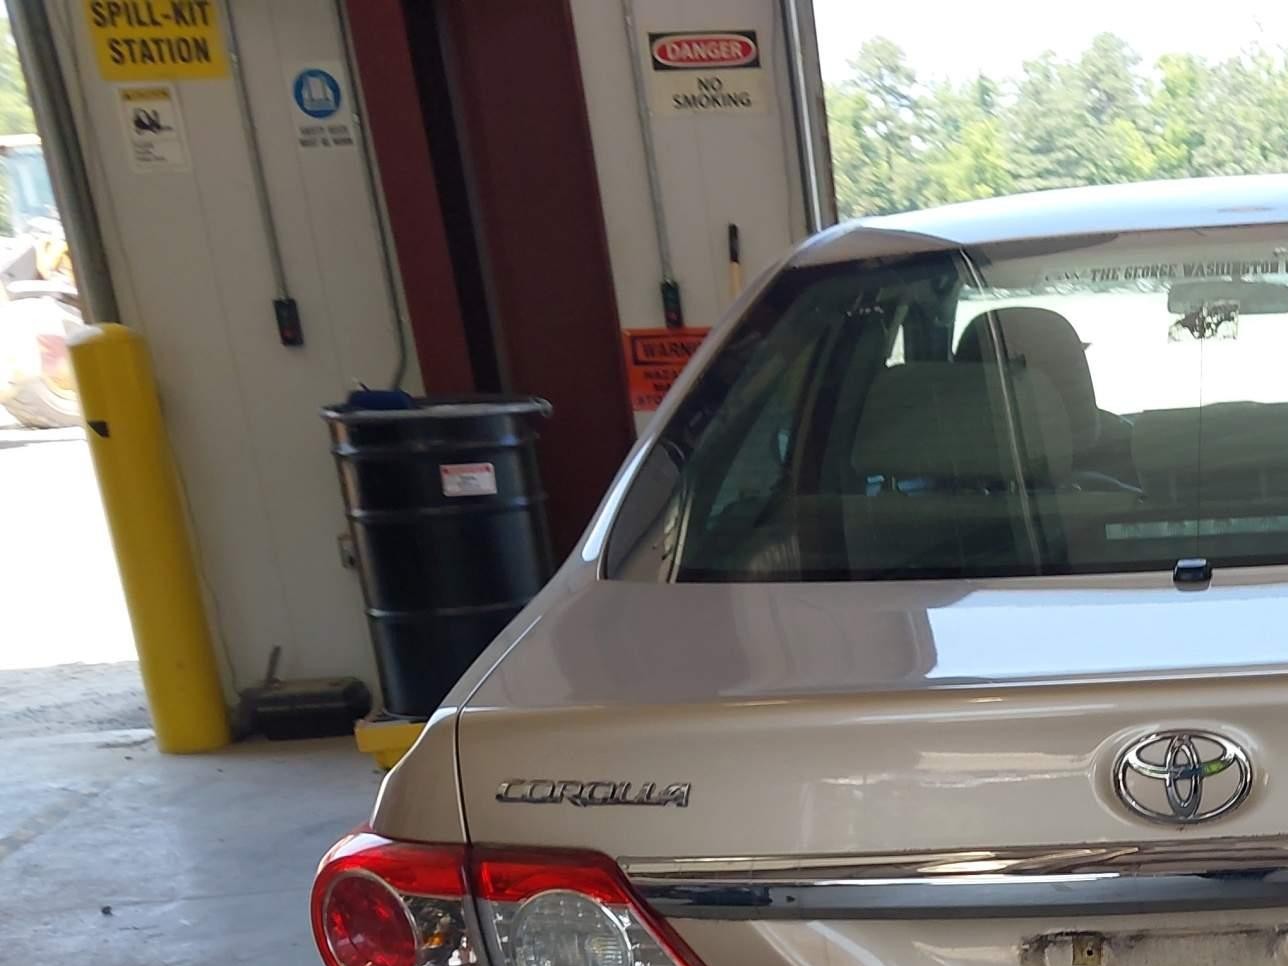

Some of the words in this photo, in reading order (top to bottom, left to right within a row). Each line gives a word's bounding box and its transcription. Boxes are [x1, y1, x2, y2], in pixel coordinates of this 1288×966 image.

[91, 0, 209, 27] SPILL-KIT
[108, 36, 211, 65] STATION
[665, 40, 743, 60] DANGER
[697, 76, 723, 92] NO
[672, 91, 752, 110] SMOKING
[1090, 267, 1121, 282] THE
[1124, 263, 1178, 281] GEORGE
[496, 779, 691, 807] COROLLA
